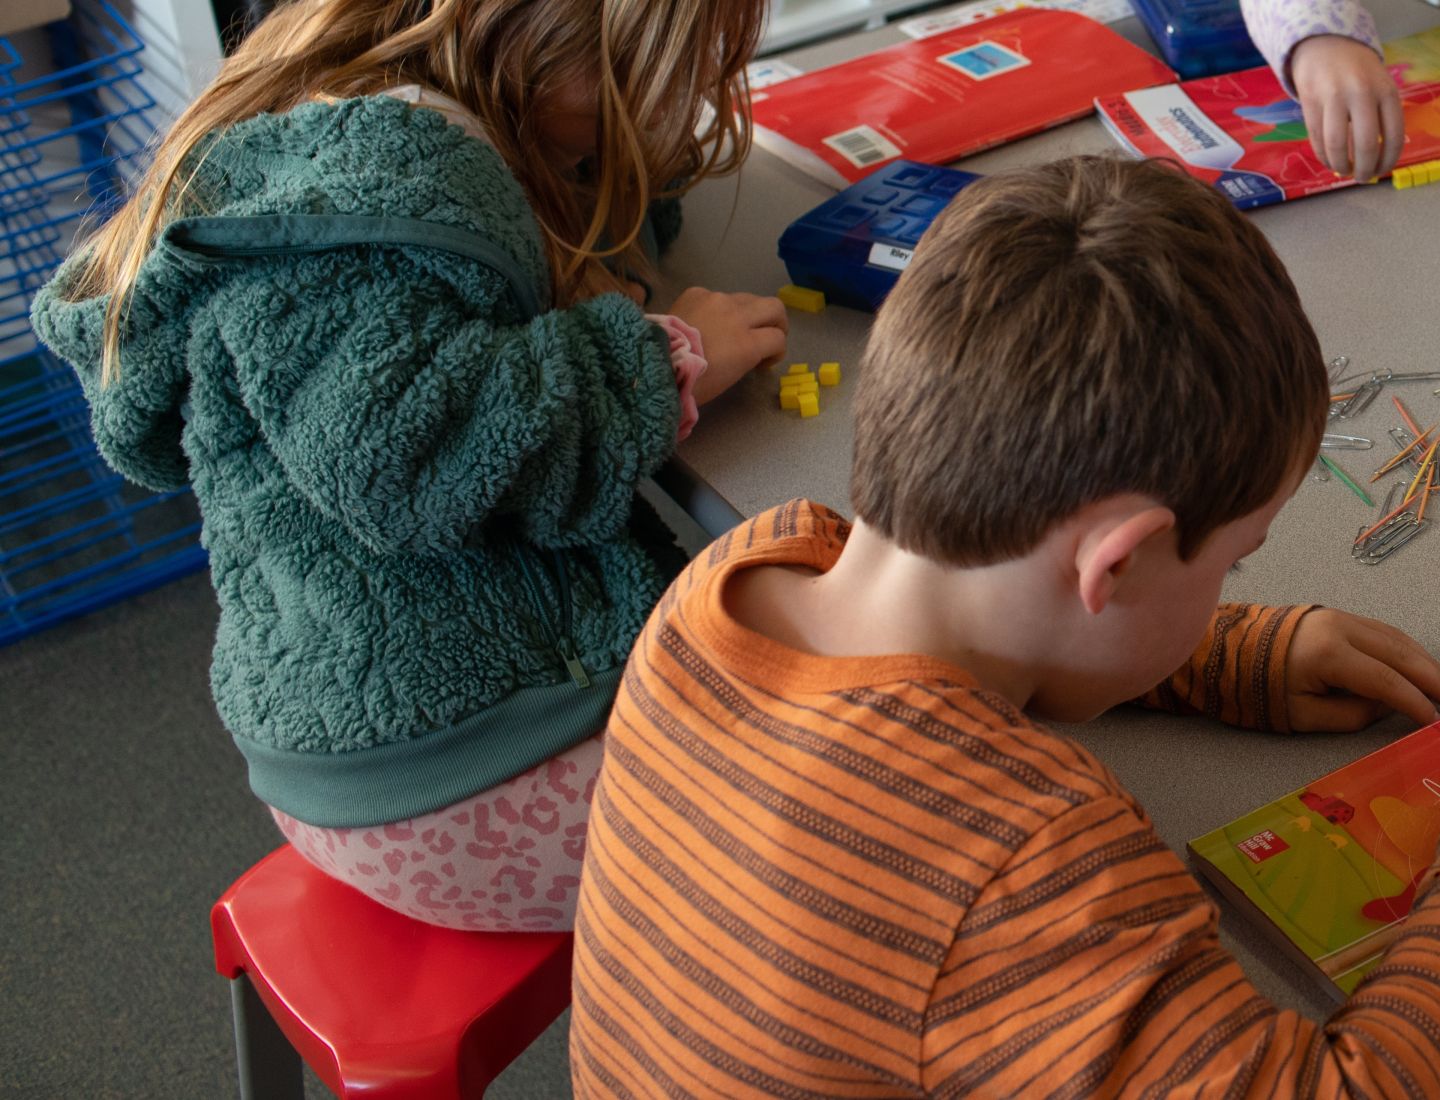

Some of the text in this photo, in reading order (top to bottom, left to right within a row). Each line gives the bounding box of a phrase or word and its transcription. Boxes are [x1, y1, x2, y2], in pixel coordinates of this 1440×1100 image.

[1260, 831, 1275, 842] Mc
[1242, 839, 1260, 850] Hill
[1253, 835, 1272, 850] Graw
